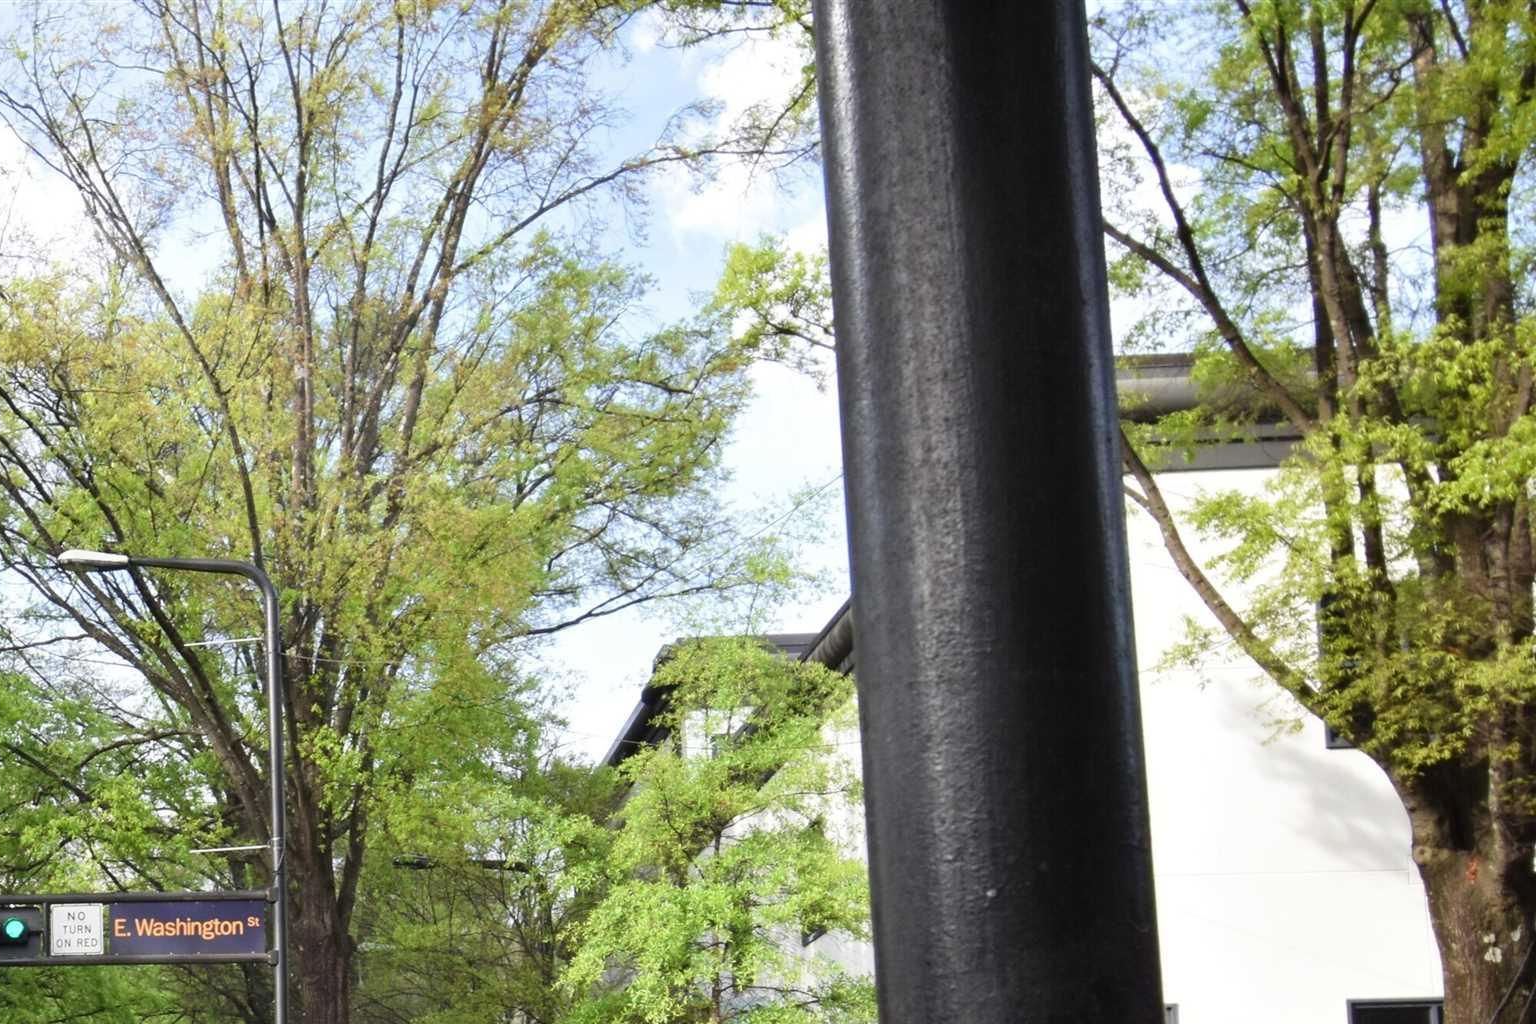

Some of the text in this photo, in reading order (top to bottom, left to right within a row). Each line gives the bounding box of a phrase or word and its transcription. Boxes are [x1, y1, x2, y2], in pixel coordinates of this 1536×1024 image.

[67, 911, 86, 921] NO
[64, 925, 92, 935] TURN
[114, 916, 260, 940] E. Washington St
[56, 938, 98, 948] ON RED
